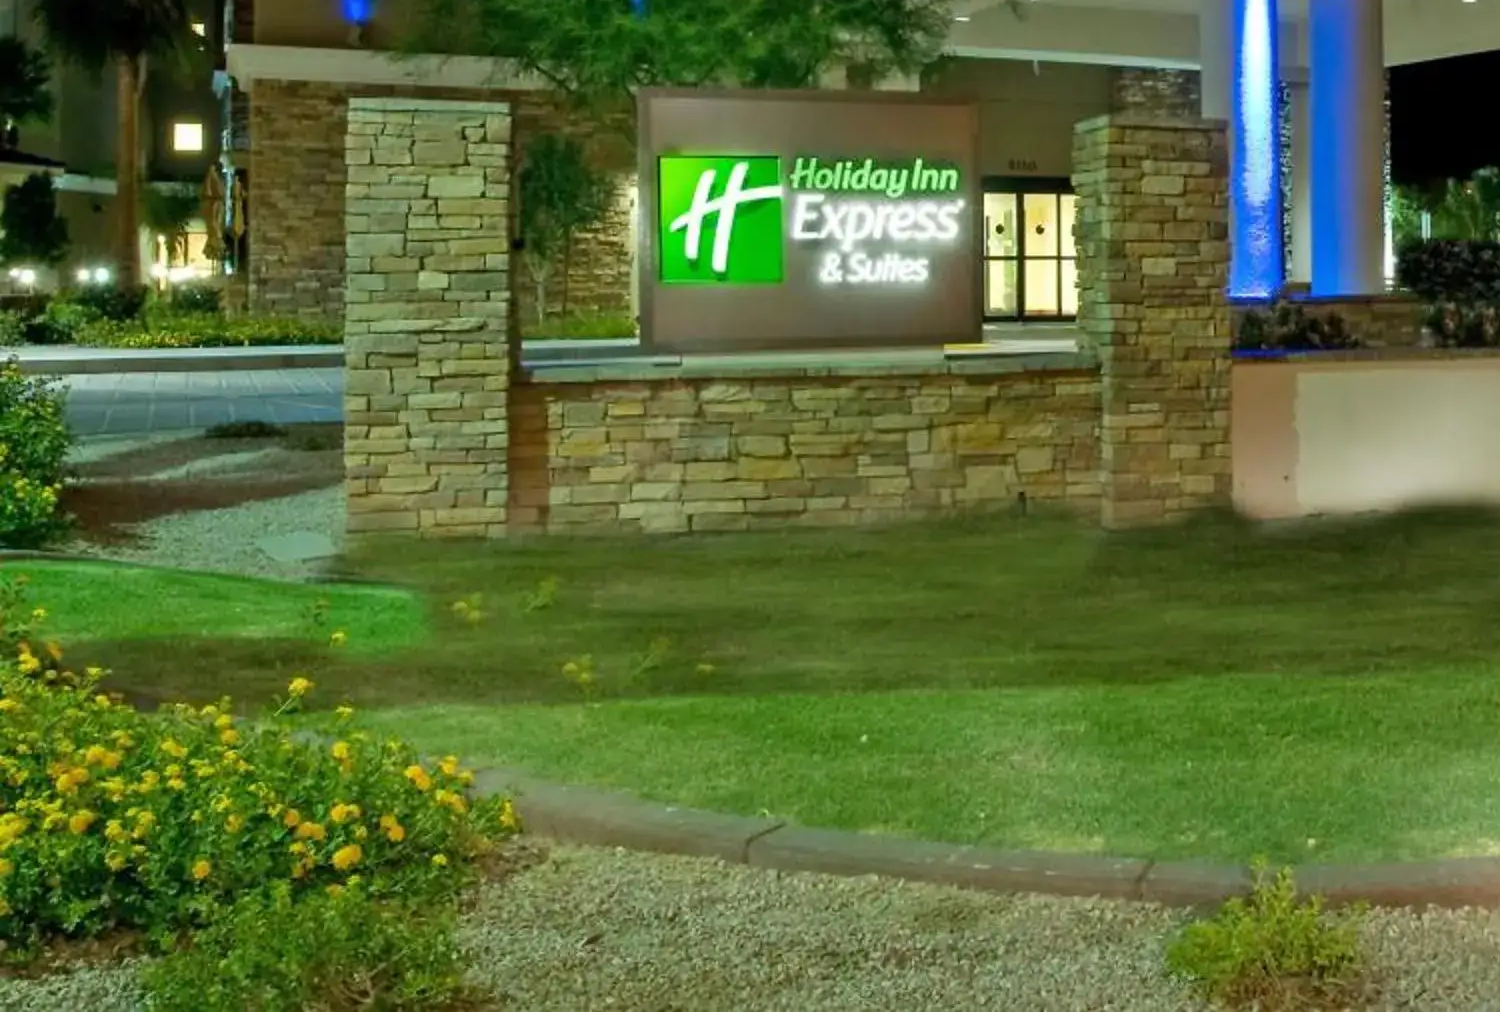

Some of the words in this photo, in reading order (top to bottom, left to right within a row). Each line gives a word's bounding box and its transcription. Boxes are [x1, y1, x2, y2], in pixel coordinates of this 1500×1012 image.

[790, 157, 909, 198] Holiday
[912, 157, 959, 191] Inn
[791, 194, 960, 251] Express
[819, 253, 842, 284] &
[847, 252, 929, 284] Suites
